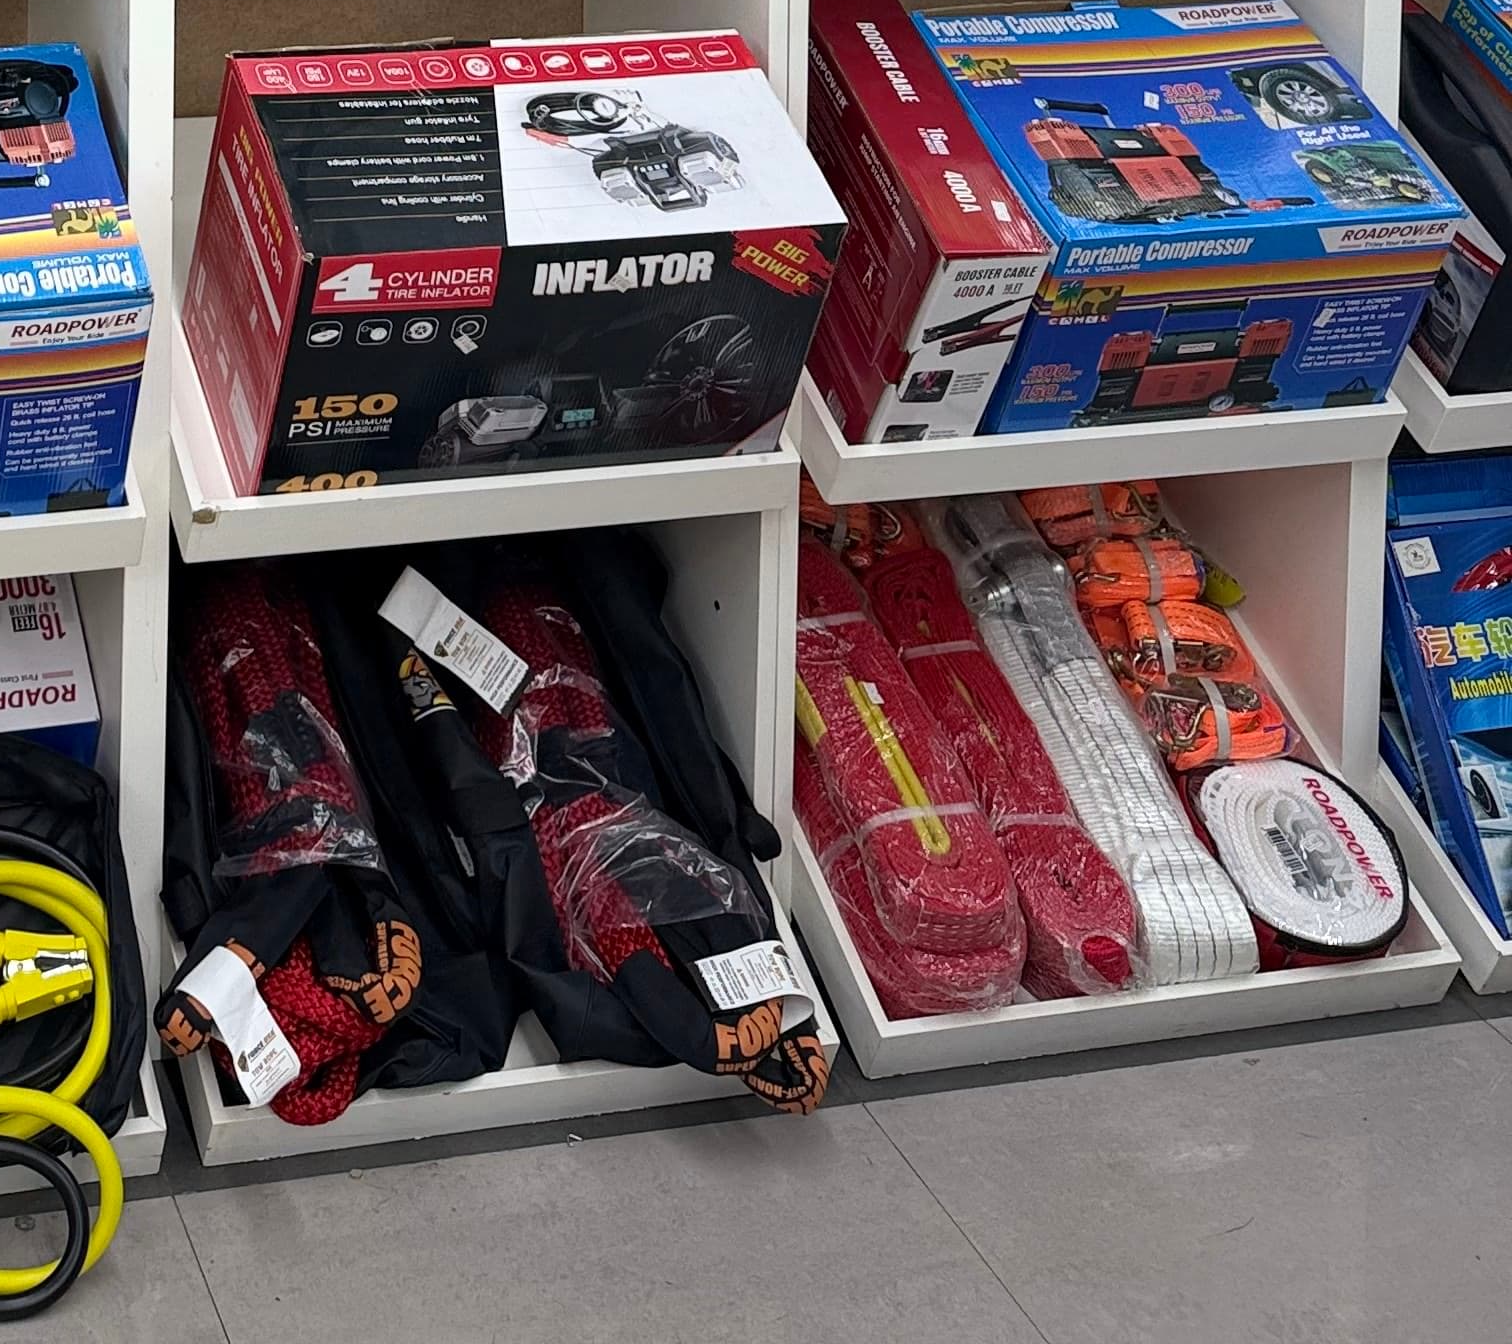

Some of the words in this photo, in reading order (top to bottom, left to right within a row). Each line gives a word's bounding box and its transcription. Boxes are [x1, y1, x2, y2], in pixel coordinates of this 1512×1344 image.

[926, 16, 1008, 37] Portable
[1005, 9, 1120, 38] Compressor
[1178, 3, 1275, 21] ROADPOWER
[231, 132, 250, 186] TIRE
[247, 179, 284, 284] INFLATOR
[1340, 221, 1450, 243] ROADPOWER
[740, 244, 811, 288] POWER
[772, 238, 811, 265] BIG
[1066, 243, 1143, 268] Portable
[1144, 235, 1255, 263] Compressor
[36, 260, 136, 294] Portable
[319, 262, 384, 302] 4
[387, 267, 494, 287] CYLINDER
[532, 250, 716, 297] INFLATOR
[954, 268, 1001, 283] BOOSTER
[1002, 265, 1038, 279] CABLE
[385, 288, 418, 300] TIRE
[420, 286, 490, 299] INFLATOR
[953, 285, 984, 298] 4000
[10, 311, 139, 339] ROADPOWER
[292, 392, 399, 421] 150
[288, 419, 331, 439] PSI
[335, 416, 393, 428] MAXIMUM
[40, 611, 67, 641] 16
[1302, 776, 1394, 900] ROADPOWER
[362, 919, 423, 1024] FORCE
